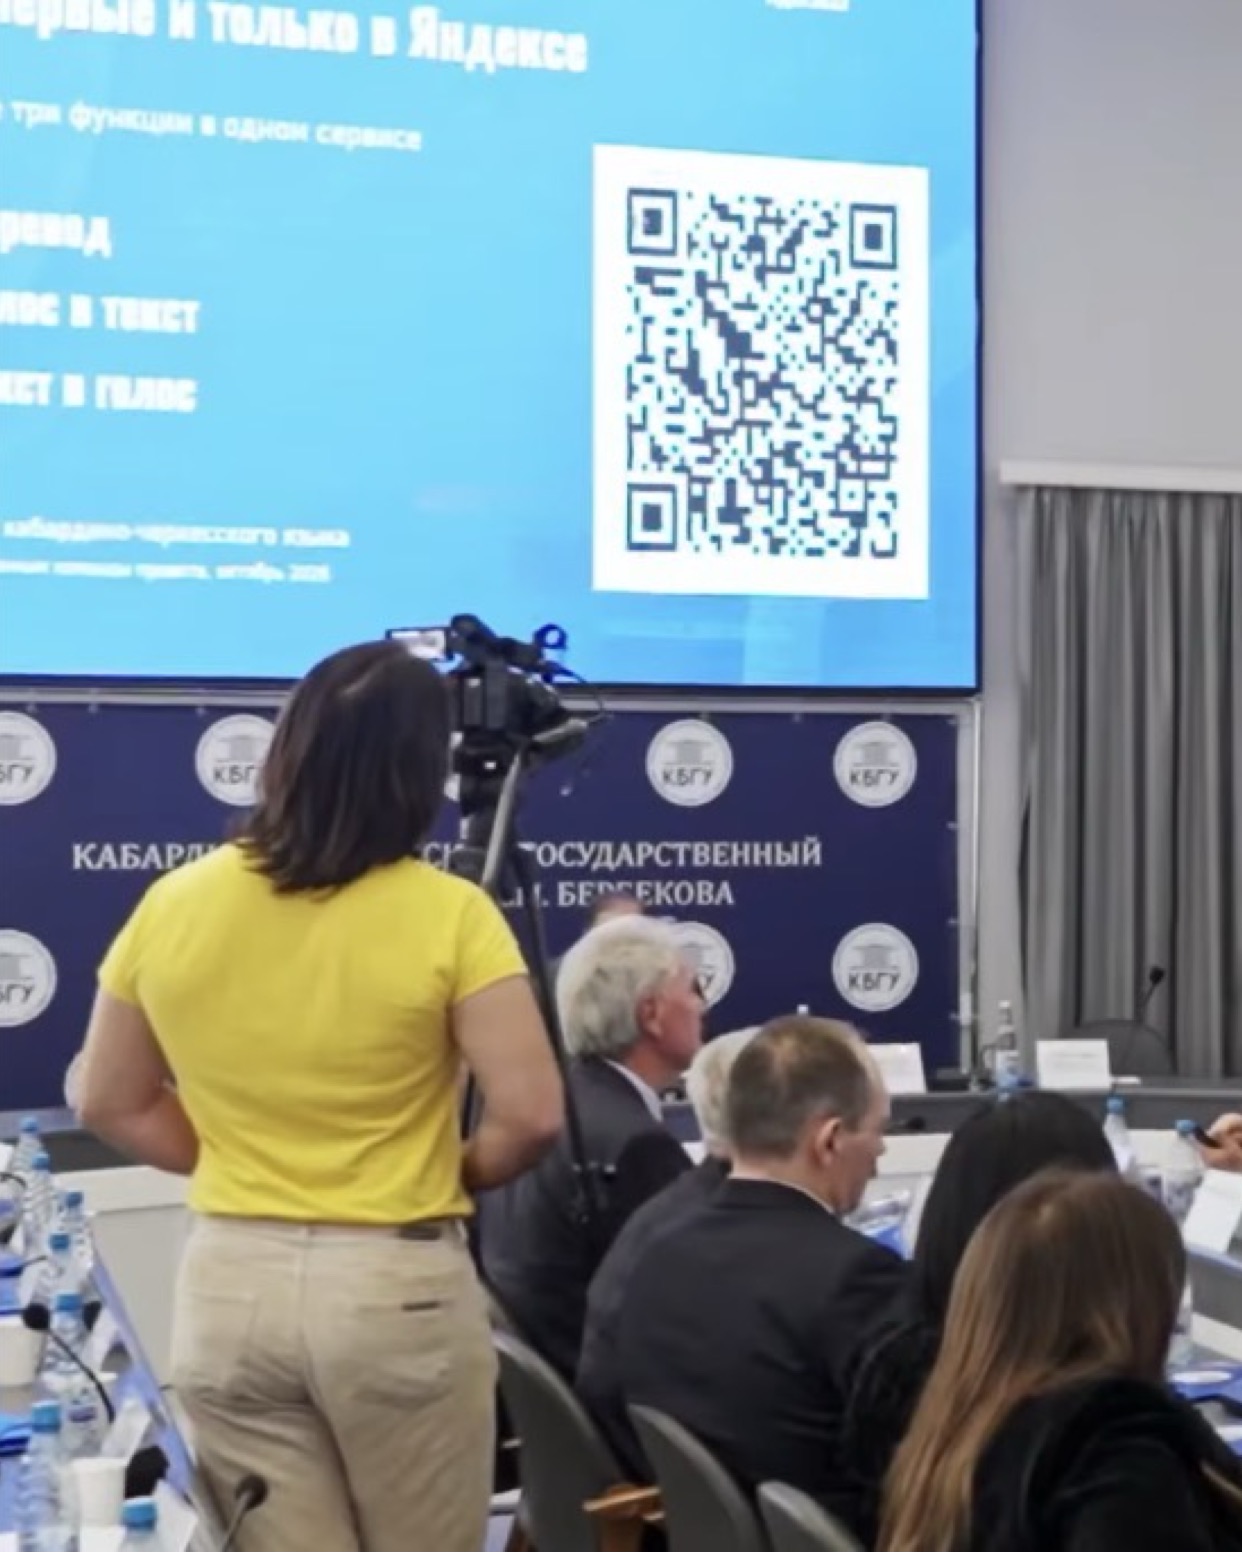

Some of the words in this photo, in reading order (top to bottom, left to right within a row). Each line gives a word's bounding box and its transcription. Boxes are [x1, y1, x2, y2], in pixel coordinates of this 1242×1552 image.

[167, 0, 196, 39] и
[210, 1, 359, 53] только
[370, 15, 397, 56] в
[407, 5, 589, 73] Яндексе
[13, 101, 61, 129] три
[69, 98, 193, 134] функции
[200, 114, 217, 137] в
[223, 116, 308, 142] одном
[315, 123, 422, 151] сервисе
[101, 296, 201, 334] текст
[94, 374, 199, 413] голос
[661, 767, 714, 787] КБГУ
[849, 768, 899, 787] КБГУ
[848, 972, 902, 992] КБГУ
